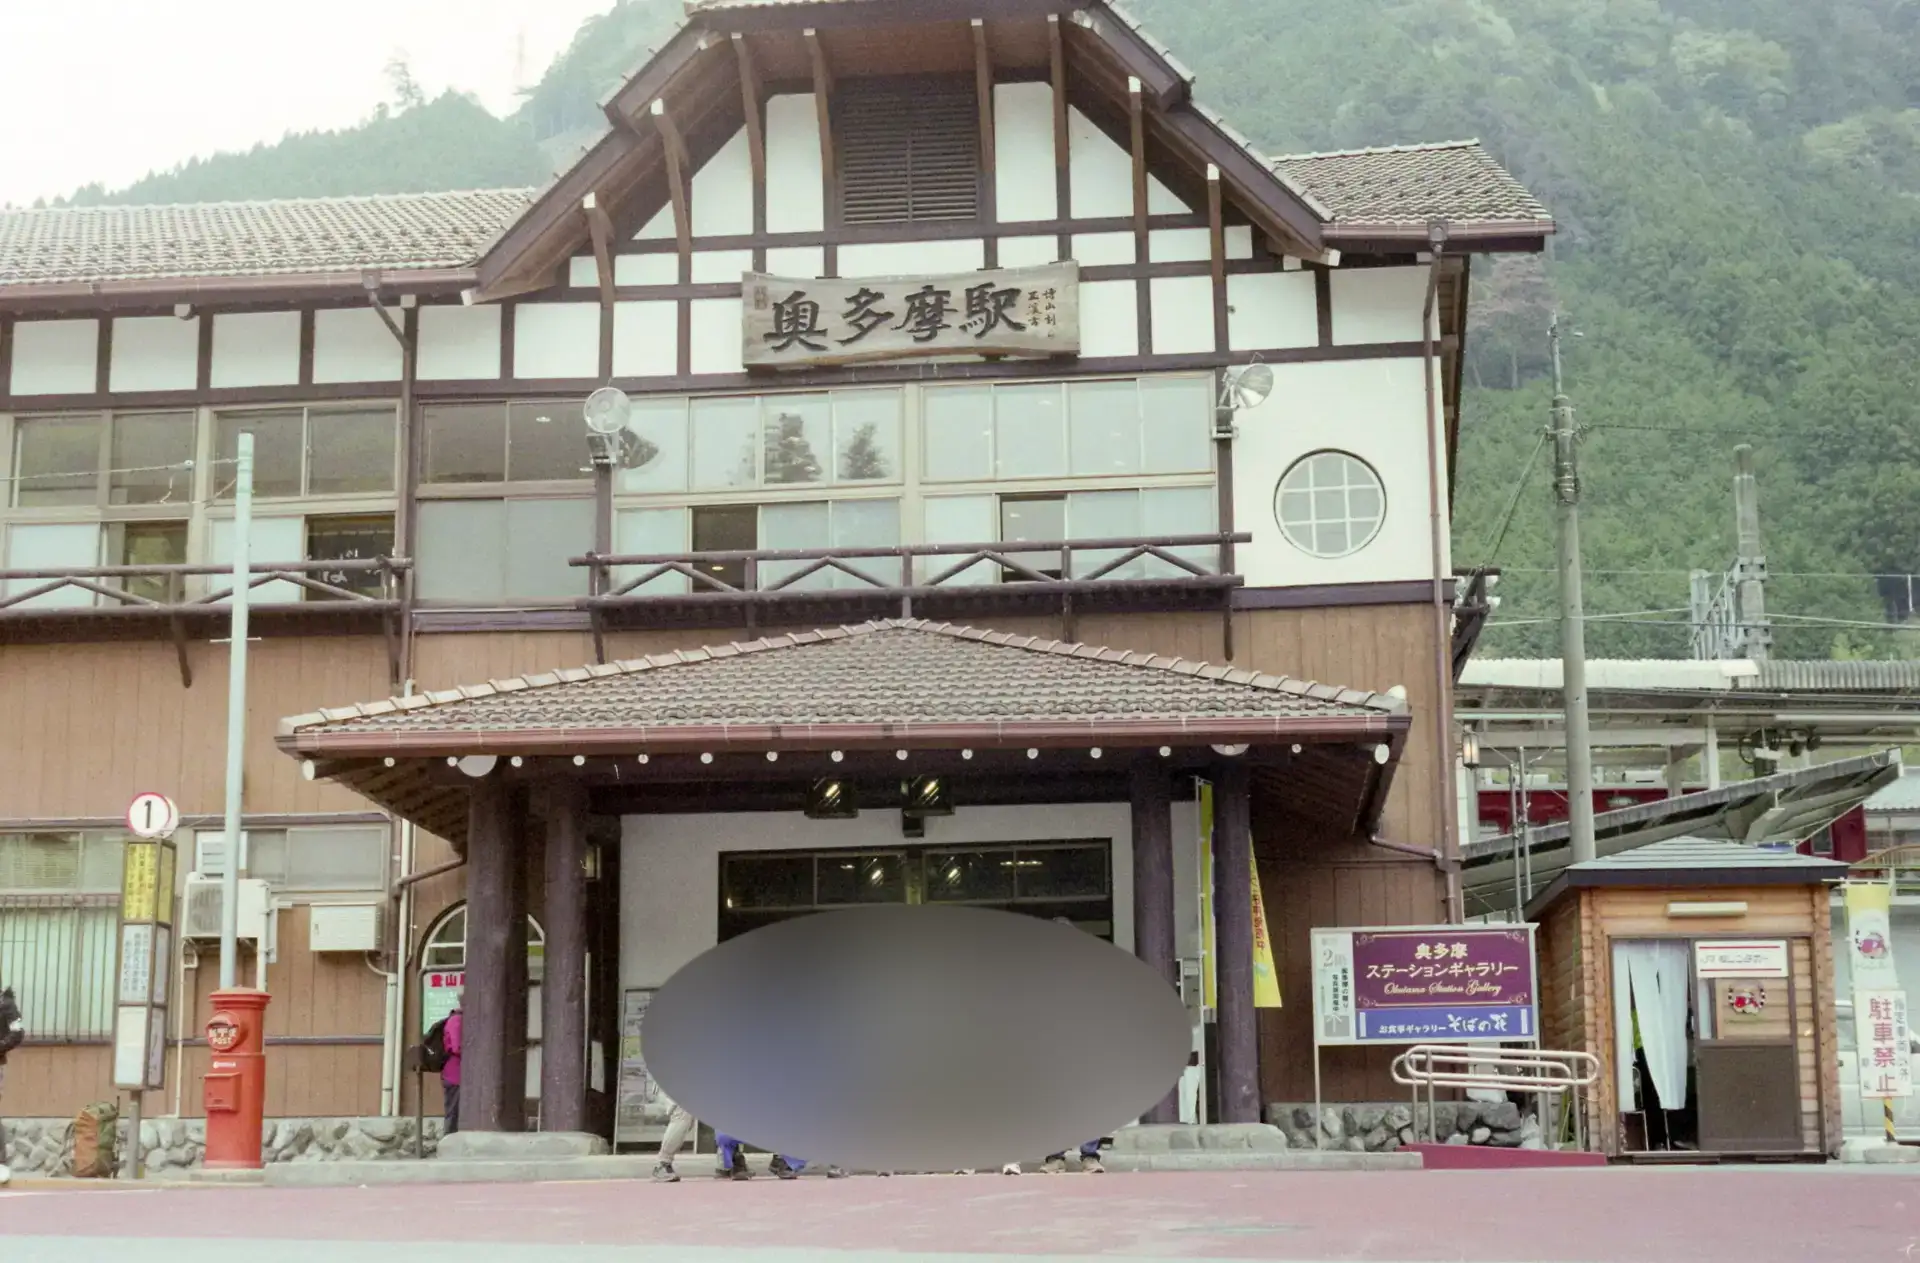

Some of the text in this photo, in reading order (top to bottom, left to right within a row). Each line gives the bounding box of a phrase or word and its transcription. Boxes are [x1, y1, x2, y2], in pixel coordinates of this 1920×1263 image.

[763, 281, 1027, 351] 奥多摩駅
[144, 800, 152, 828] 1
[1415, 942, 1468, 959] 奥多摩
[1366, 962, 1519, 979] ステーションギャラリー
[1384, 979, 1502, 997] Okutama Station Gallery
[1447, 1012, 1508, 1033] そばの花
[1869, 998, 1897, 1092] 駐車禁止
